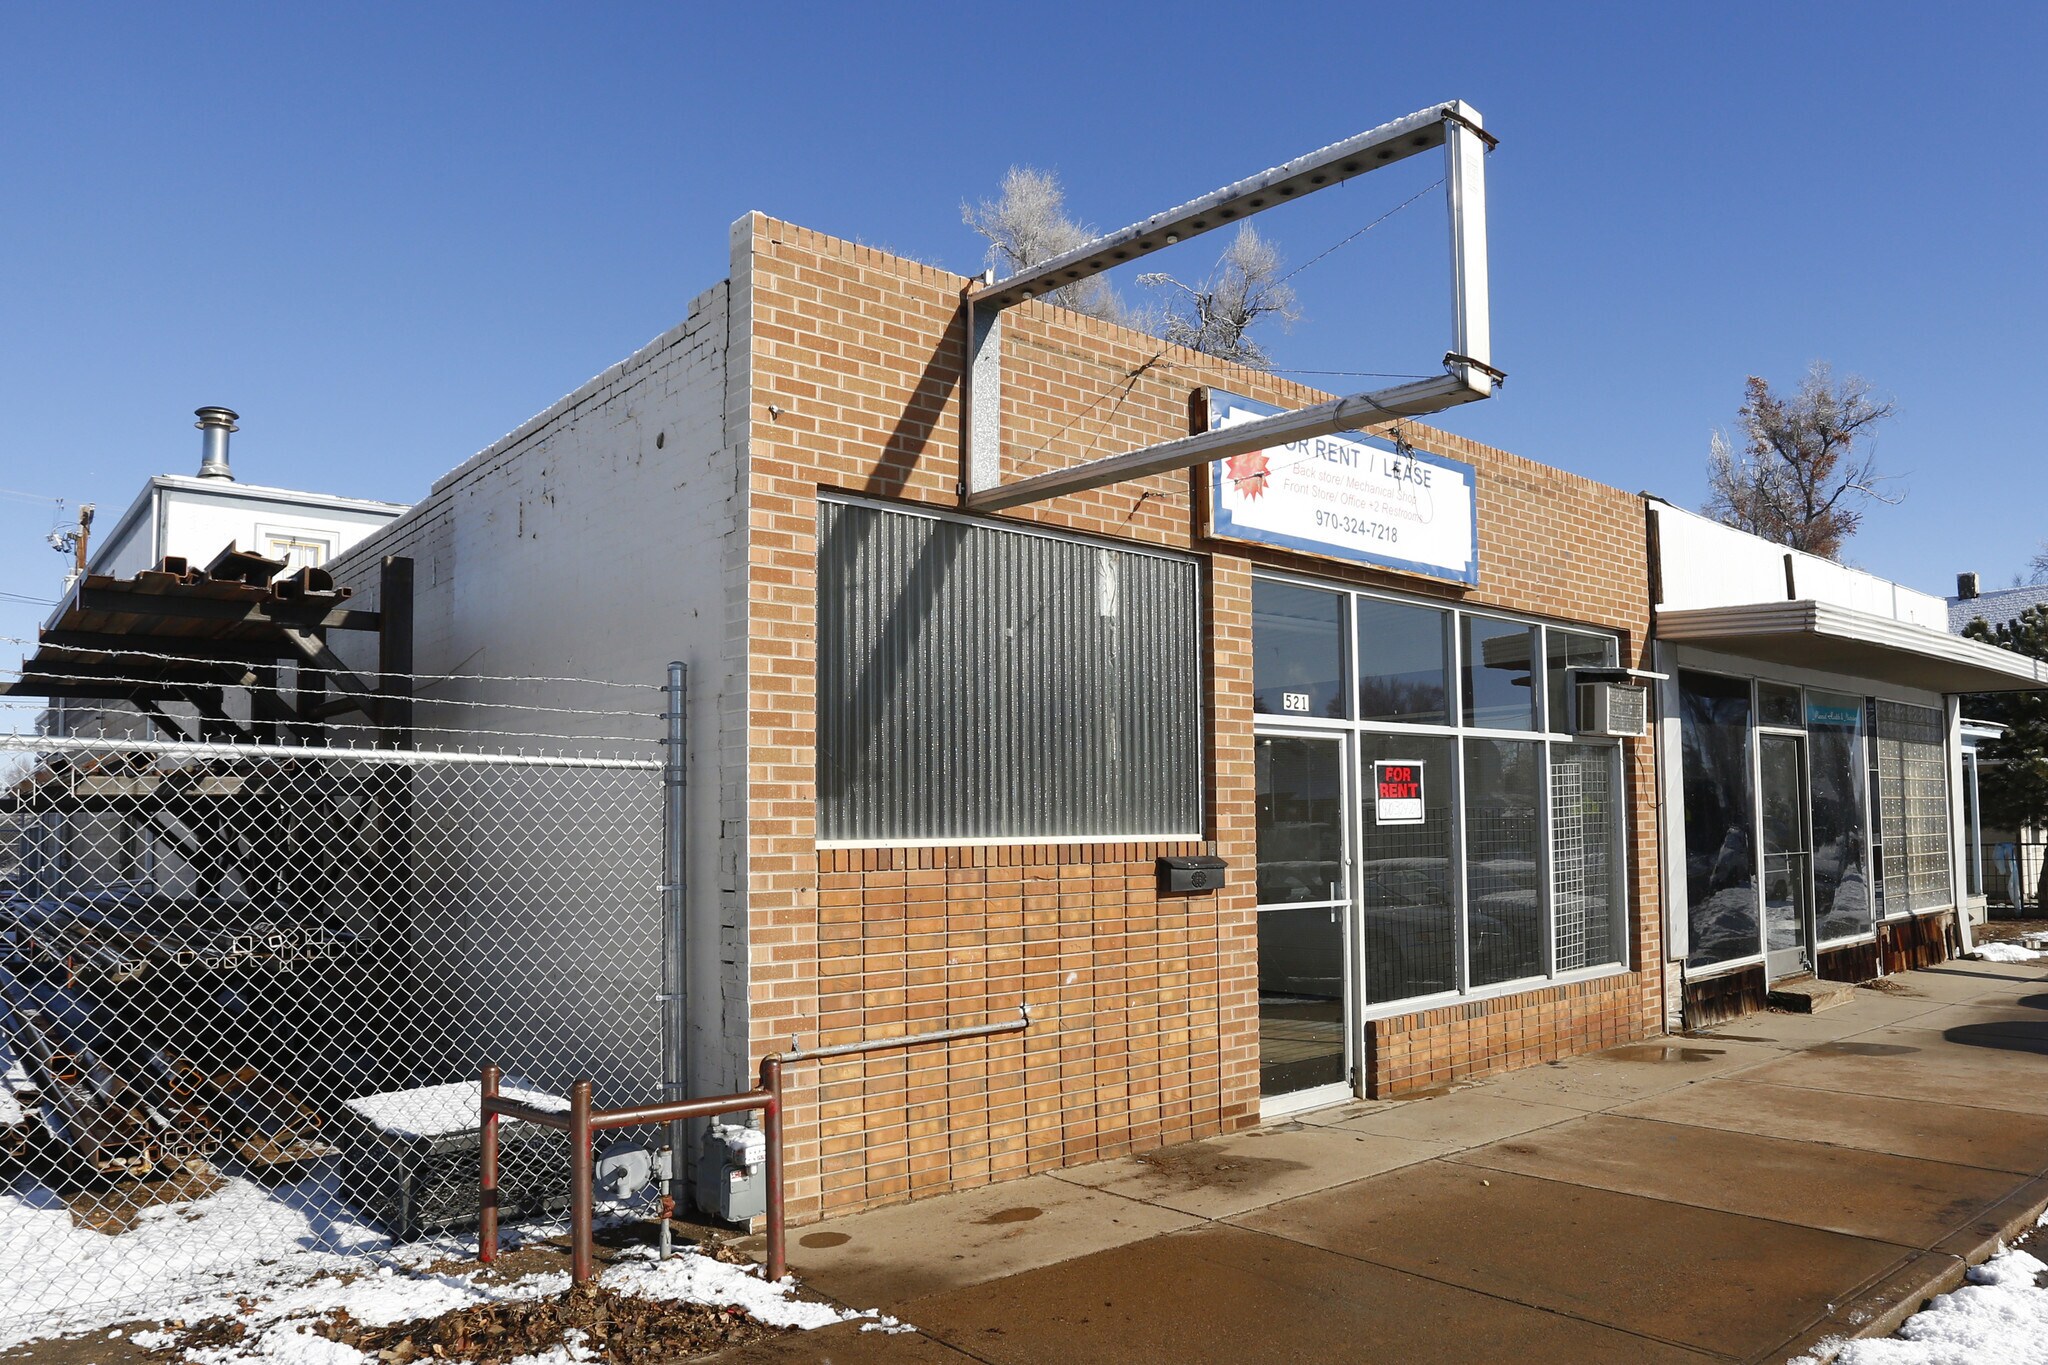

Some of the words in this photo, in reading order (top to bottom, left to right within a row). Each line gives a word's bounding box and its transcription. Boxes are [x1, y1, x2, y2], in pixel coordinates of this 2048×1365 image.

[1315, 439, 1361, 468] RENT
[1384, 458, 1432, 487] LEASE
[1283, 478, 1309, 496] Front
[1340, 493, 1366, 510] Office
[1381, 502, 1424, 524] Restrooms
[1292, 463, 1316, 479] Back
[1346, 476, 1395, 499] Mechanical
[1397, 489, 1417, 507] Shop
[1315, 509, 1398, 543] 970-324-7218
[1285, 694, 1307, 710] 521
[1379, 783, 1419, 798] RENT
[1385, 767, 1412, 782] FOR
